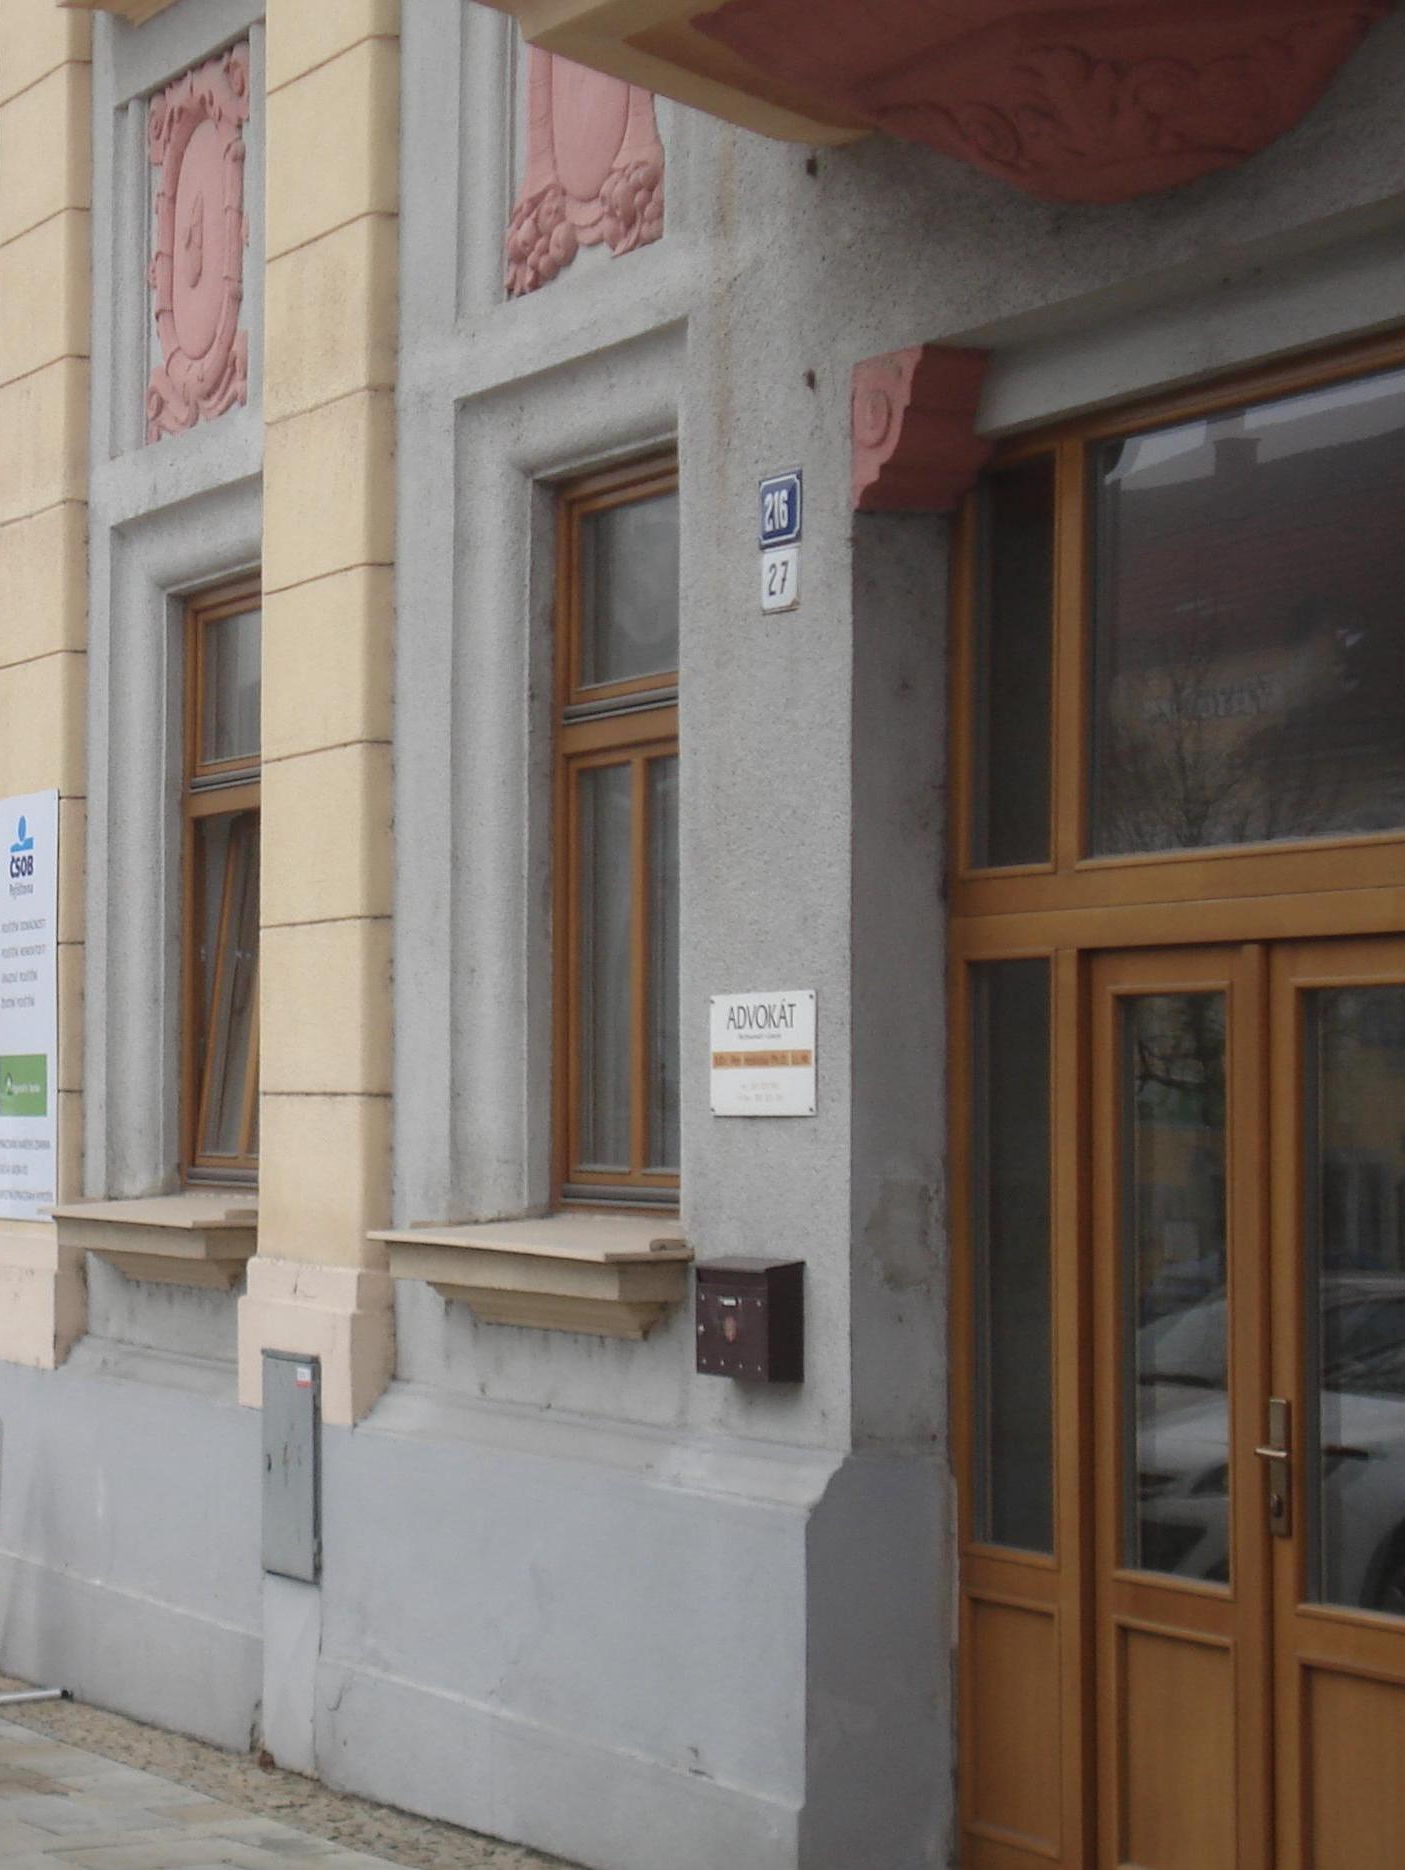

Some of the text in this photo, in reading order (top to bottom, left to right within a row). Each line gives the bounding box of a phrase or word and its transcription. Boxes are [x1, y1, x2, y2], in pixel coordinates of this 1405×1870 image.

[764, 489, 788, 531] 216
[768, 560, 788, 596] 27
[9, 855, 34, 878] ČSOB
[727, 998, 796, 1030] ADVOKÁT
